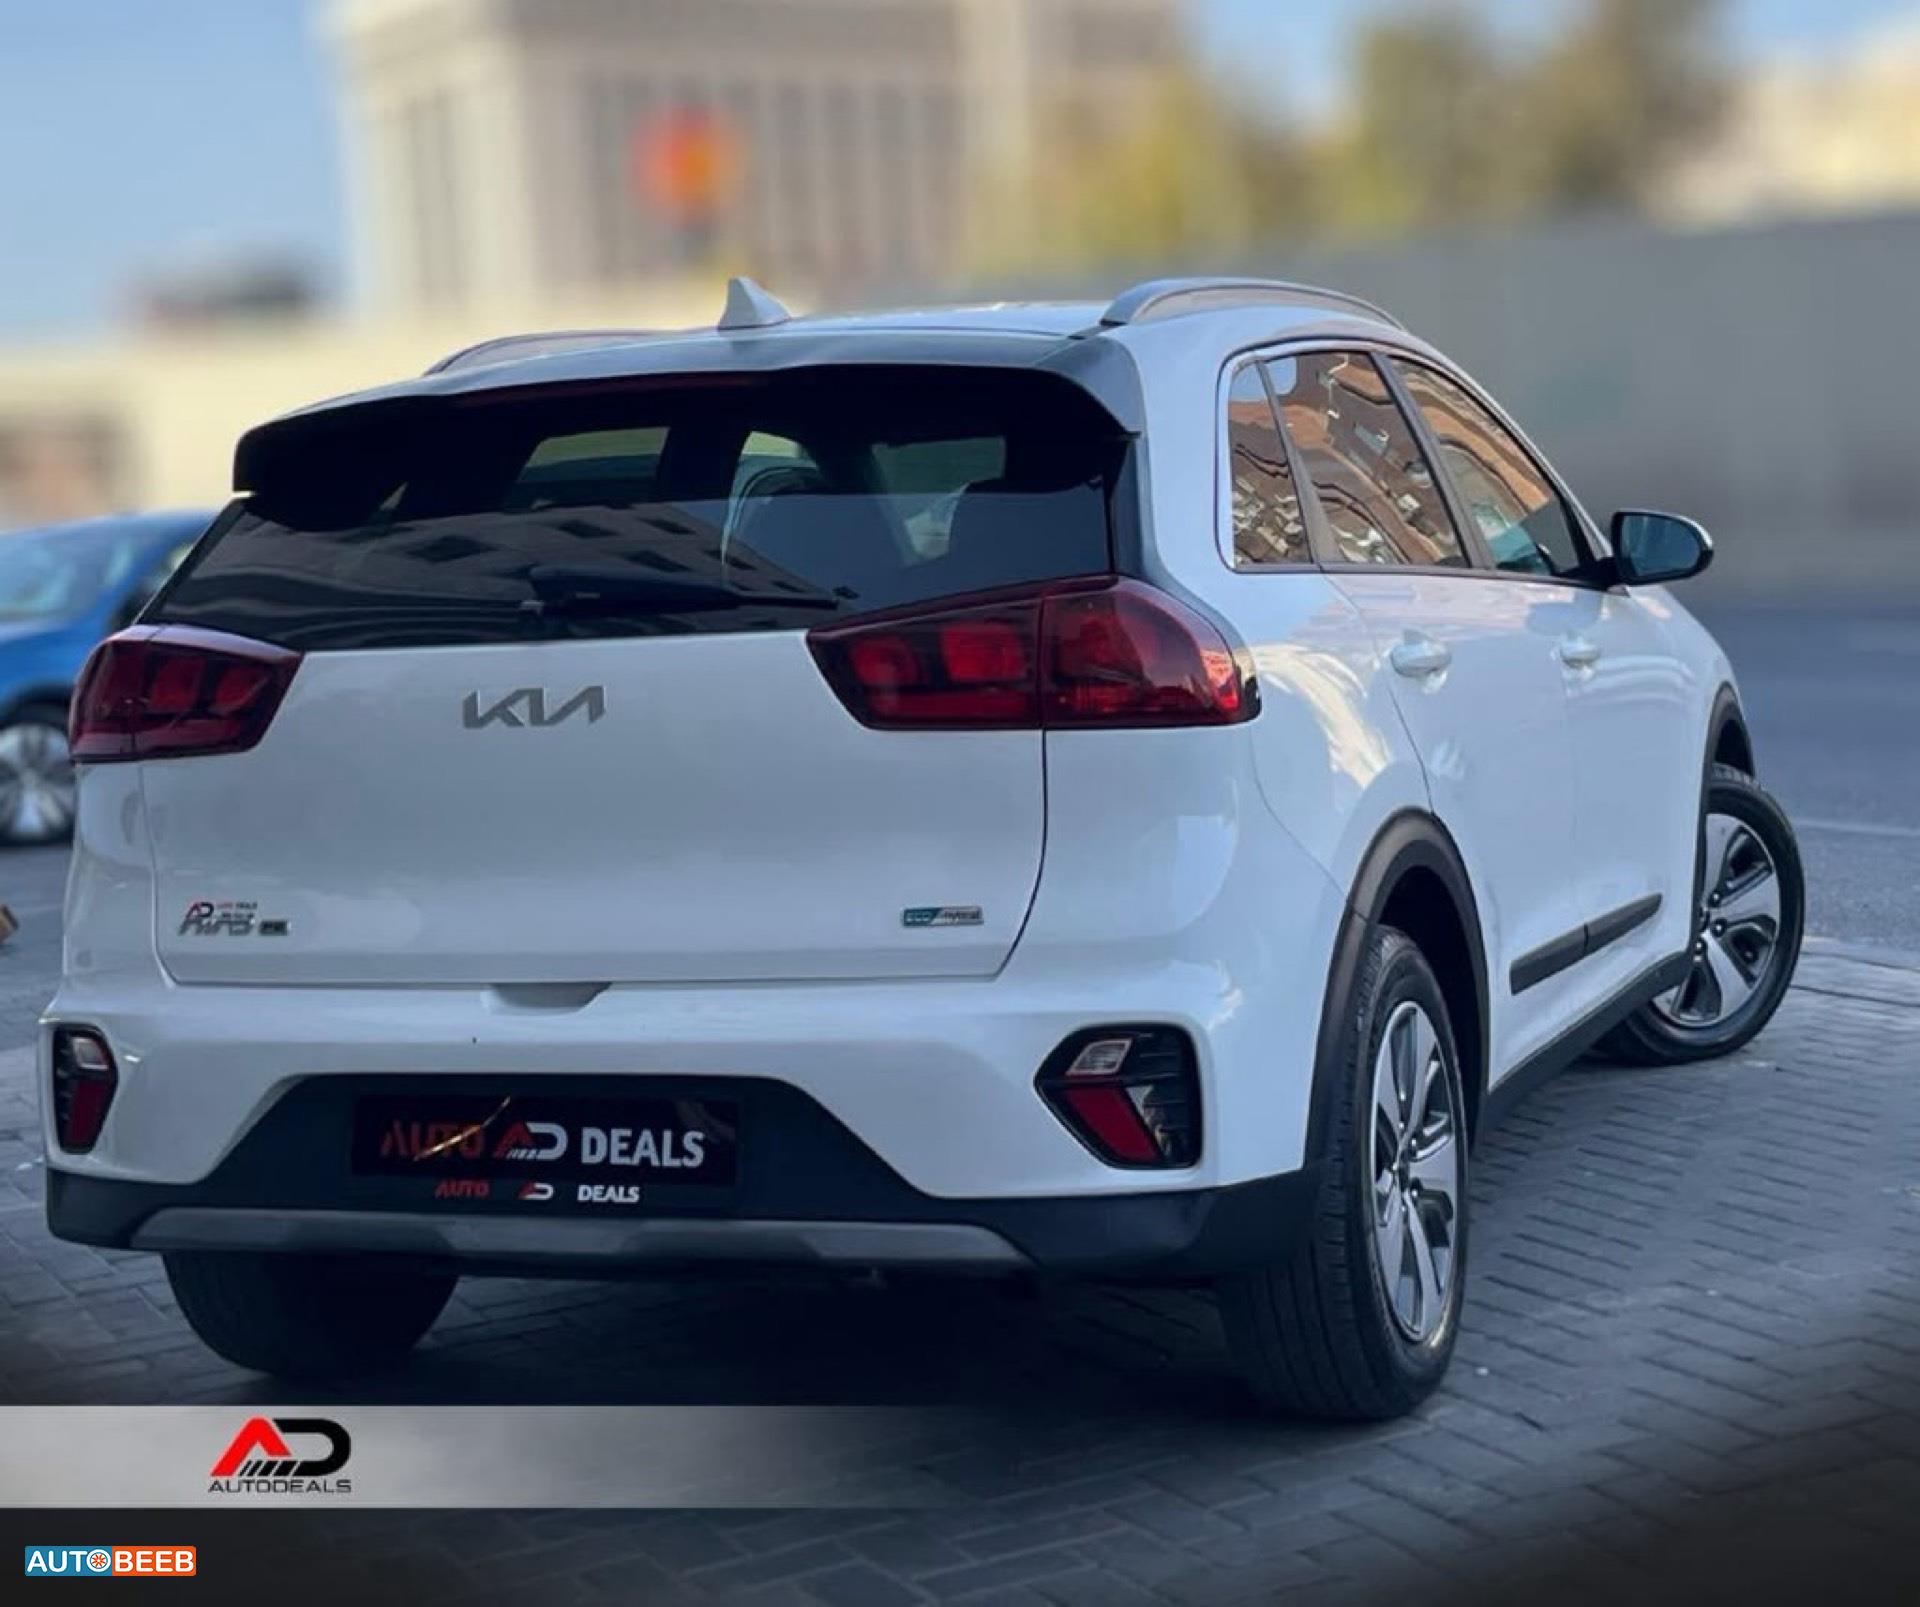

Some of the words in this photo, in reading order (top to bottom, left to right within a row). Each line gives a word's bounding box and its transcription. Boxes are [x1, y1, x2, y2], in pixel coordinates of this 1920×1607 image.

[463, 685, 605, 728] KIA
[381, 1121, 485, 1158] AUTO
[580, 1126, 705, 1168] DEALS
[435, 1179, 489, 1198] AUTO
[577, 1184, 640, 1203] DEALS
